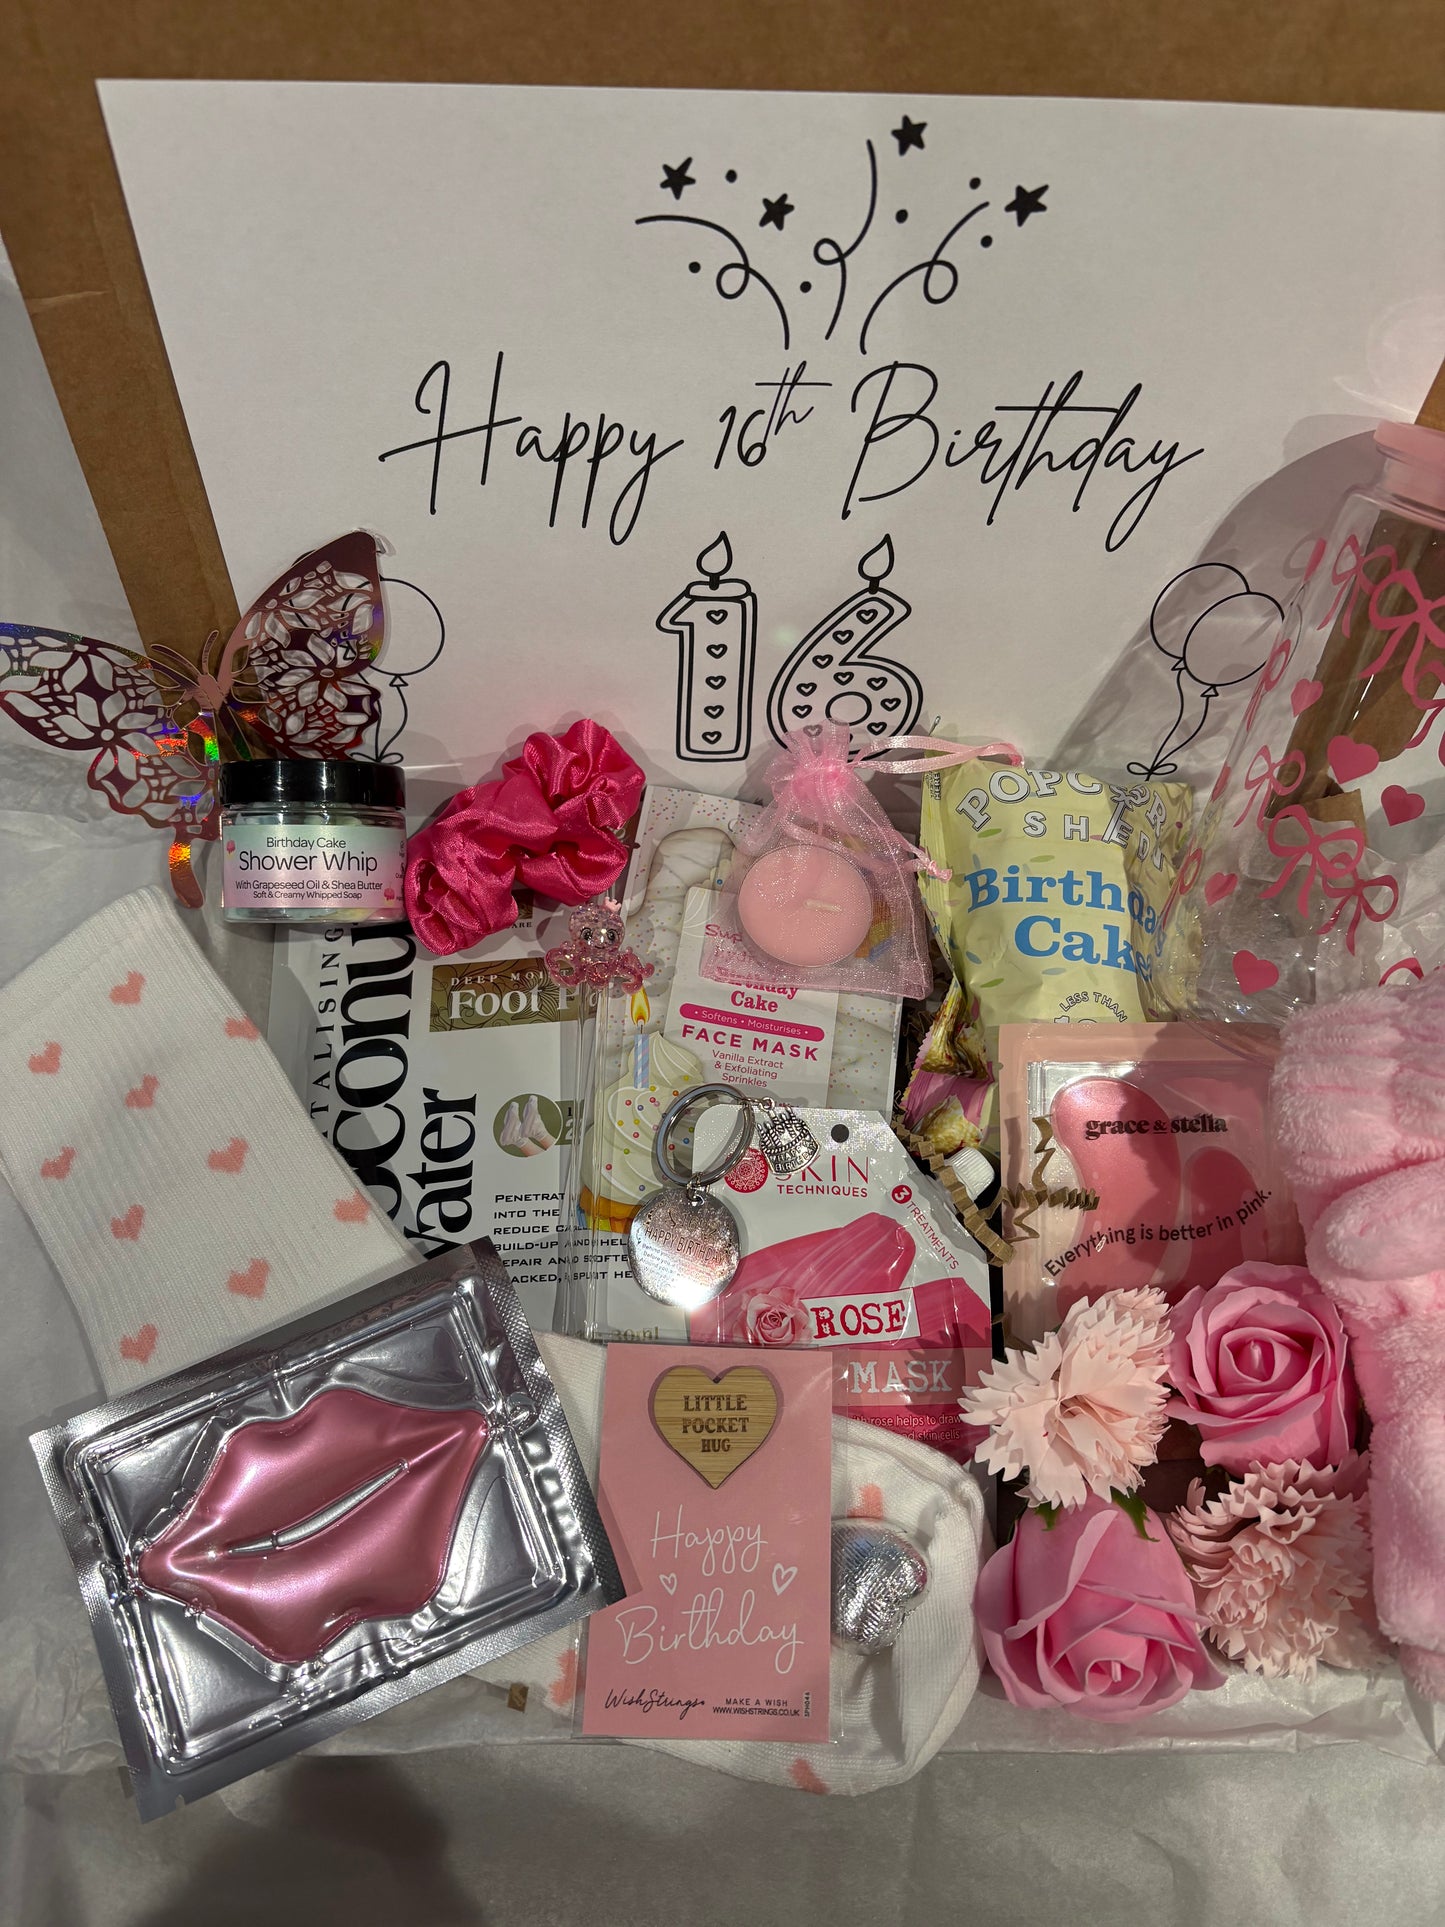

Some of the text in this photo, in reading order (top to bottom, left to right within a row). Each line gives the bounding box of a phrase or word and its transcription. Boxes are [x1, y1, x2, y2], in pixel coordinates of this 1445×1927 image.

[378, 351, 1205, 552] Happy 16th Birthday
[266, 837, 347, 851] Birthday Cake
[239, 851, 318, 872] Shower
[322, 851, 378, 876] Whip
[235, 879, 383, 892] With Grapeseed Oil & Shea Butter
[253, 890, 362, 901] Soft & Creamy Whipped Soap
[1015, 915, 1152, 982] Cake
[451, 974, 498, 986] DEEP
[449, 985, 542, 1020] Foot
[729, 989, 778, 1013] Cake
[1059, 991, 1128, 1023] LESS THAN
[311, 926, 344, 1138] TALISING
[701, 1010, 802, 1036] Softens Moisturises
[681, 1024, 819, 1062] FACE MASK
[712, 1049, 784, 1070] Vanilla Extract
[714, 1060, 778, 1080] & Exfoliating
[721, 1071, 768, 1088] Sprinkles
[1085, 1112, 1228, 1141] grace & stella
[775, 1155, 869, 1184] KIN
[494, 1192, 566, 1203] PENETRAT
[776, 1184, 869, 1198] TECHNIQUES
[494, 1209, 561, 1219] INTO THE
[493, 1226, 550, 1235] REDUCE
[895, 1188, 960, 1271] 3 TREATMENTS
[1044, 1188, 1273, 1277] Everything is better in pink.
[494, 1241, 559, 1251] BUILD-UP
[600, 1238, 628, 1247] HEL
[645, 1227, 725, 1263] HAPPY BIRTHDAY
[502, 1257, 542, 1268] EPAIR
[583, 1254, 628, 1263] SOFTE
[511, 1274, 562, 1284] ACKED,
[810, 1300, 908, 1340] ROSE
[850, 1360, 952, 1393] MASK
[683, 1394, 748, 1412] LITTLE
[682, 1417, 749, 1434] POCKET
[870, 1416, 893, 1426] rose
[896, 1415, 924, 1429] helps
[926, 1415, 937, 1425] to
[938, 1413, 961, 1424] draw
[917, 1429, 938, 1441] skin
[940, 1429, 960, 1439] cells
[701, 1438, 731, 1454] HUG
[650, 1504, 768, 1577] Happy
[615, 1587, 804, 1675] Birthday
[713, 1706, 800, 1717] WWW.WISHSTRINGS.CO.UK
[725, 1698, 788, 1707] MAKE A WISH
